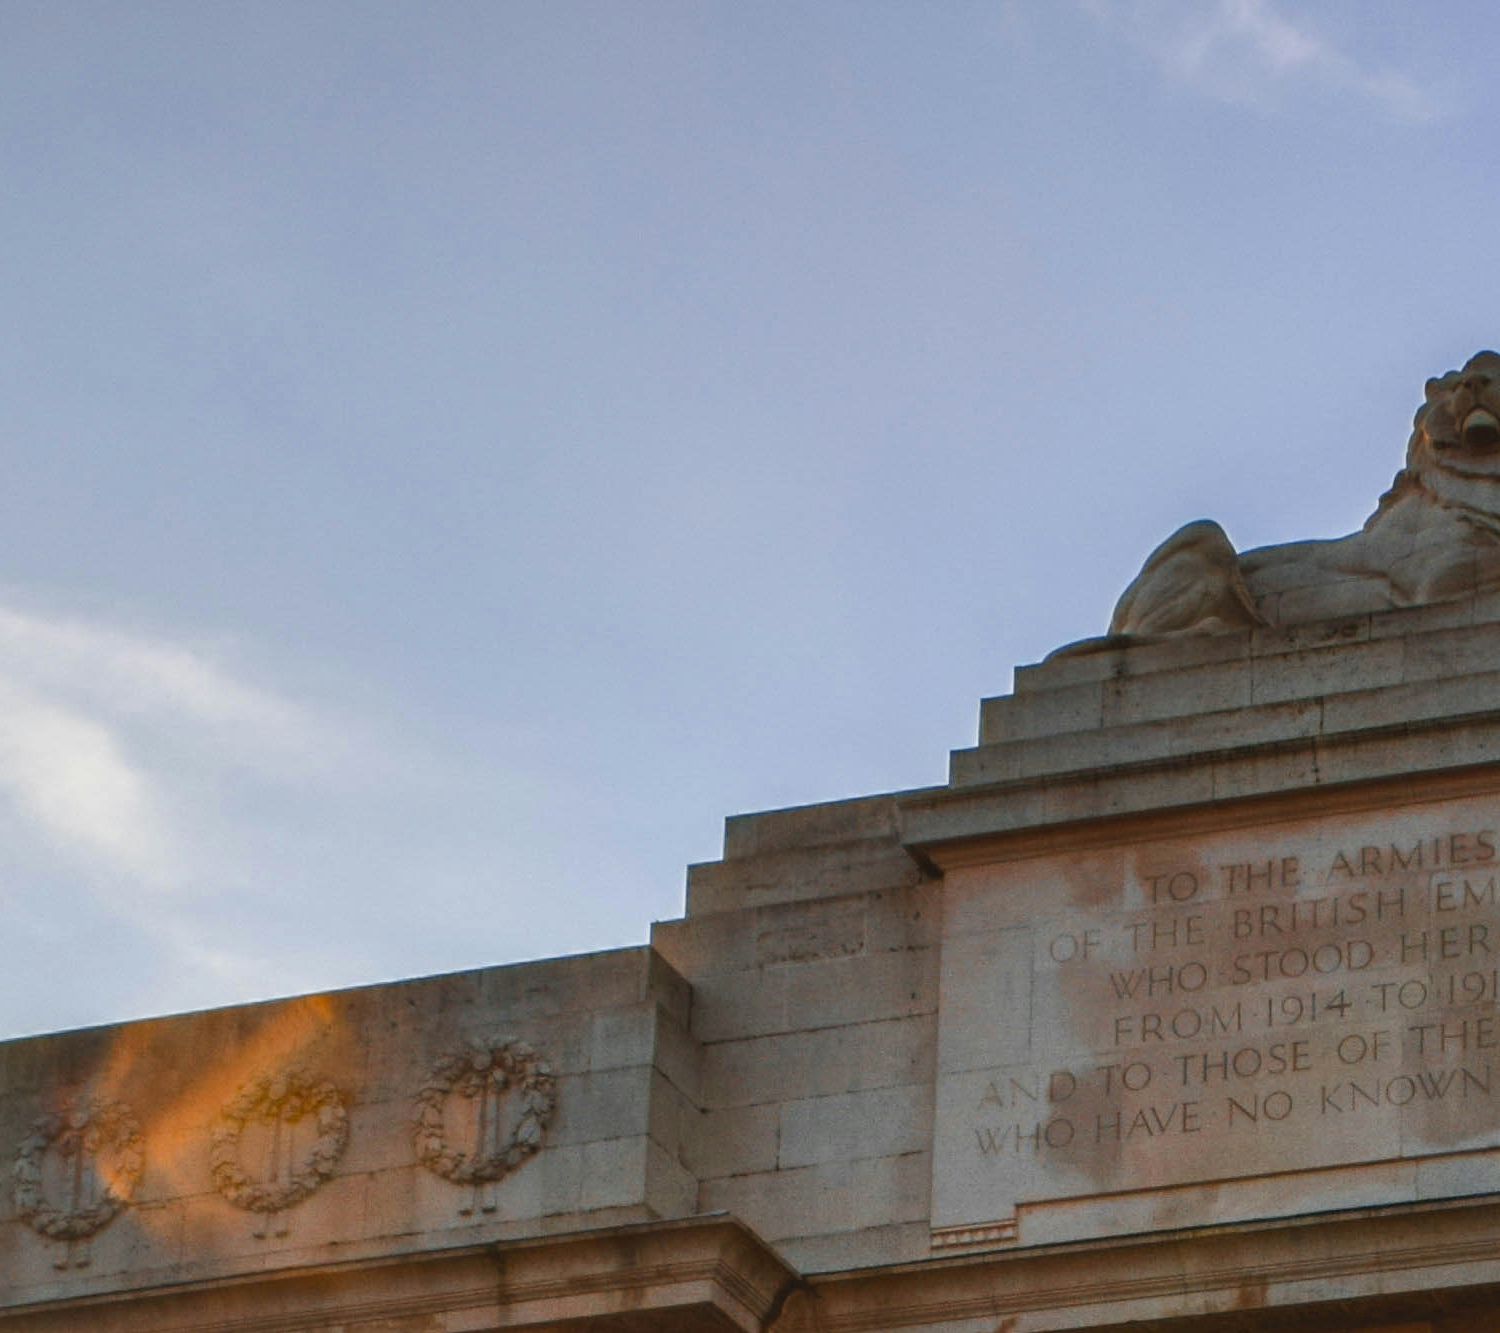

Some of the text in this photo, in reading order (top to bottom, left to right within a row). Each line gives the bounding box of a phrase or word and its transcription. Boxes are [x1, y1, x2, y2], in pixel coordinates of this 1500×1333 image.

[1144, 829, 1497, 905] TO THE ARMIES
[1050, 928, 1101, 964] OF
[1123, 914, 1205, 952] THE
[1233, 887, 1405, 940] BRITISH
[1108, 961, 1208, 1000] WHO
[1231, 940, 1375, 986] STOOD
[1113, 1002, 1243, 1046] FROM
[1267, 988, 1352, 1028] 1914
[1371, 979, 1428, 1013] TO
[976, 1070, 1077, 1110] AND
[1095, 1061, 1152, 1095] TO
[1173, 1040, 1313, 1086] THOSE
[1337, 1030, 1390, 1066] OF
[973, 1117, 1075, 1155] WHO
[1095, 1101, 1202, 1144] HAVE
[1227, 1090, 1294, 1127] NO
[1319, 1064, 1492, 1115] KNOWN
